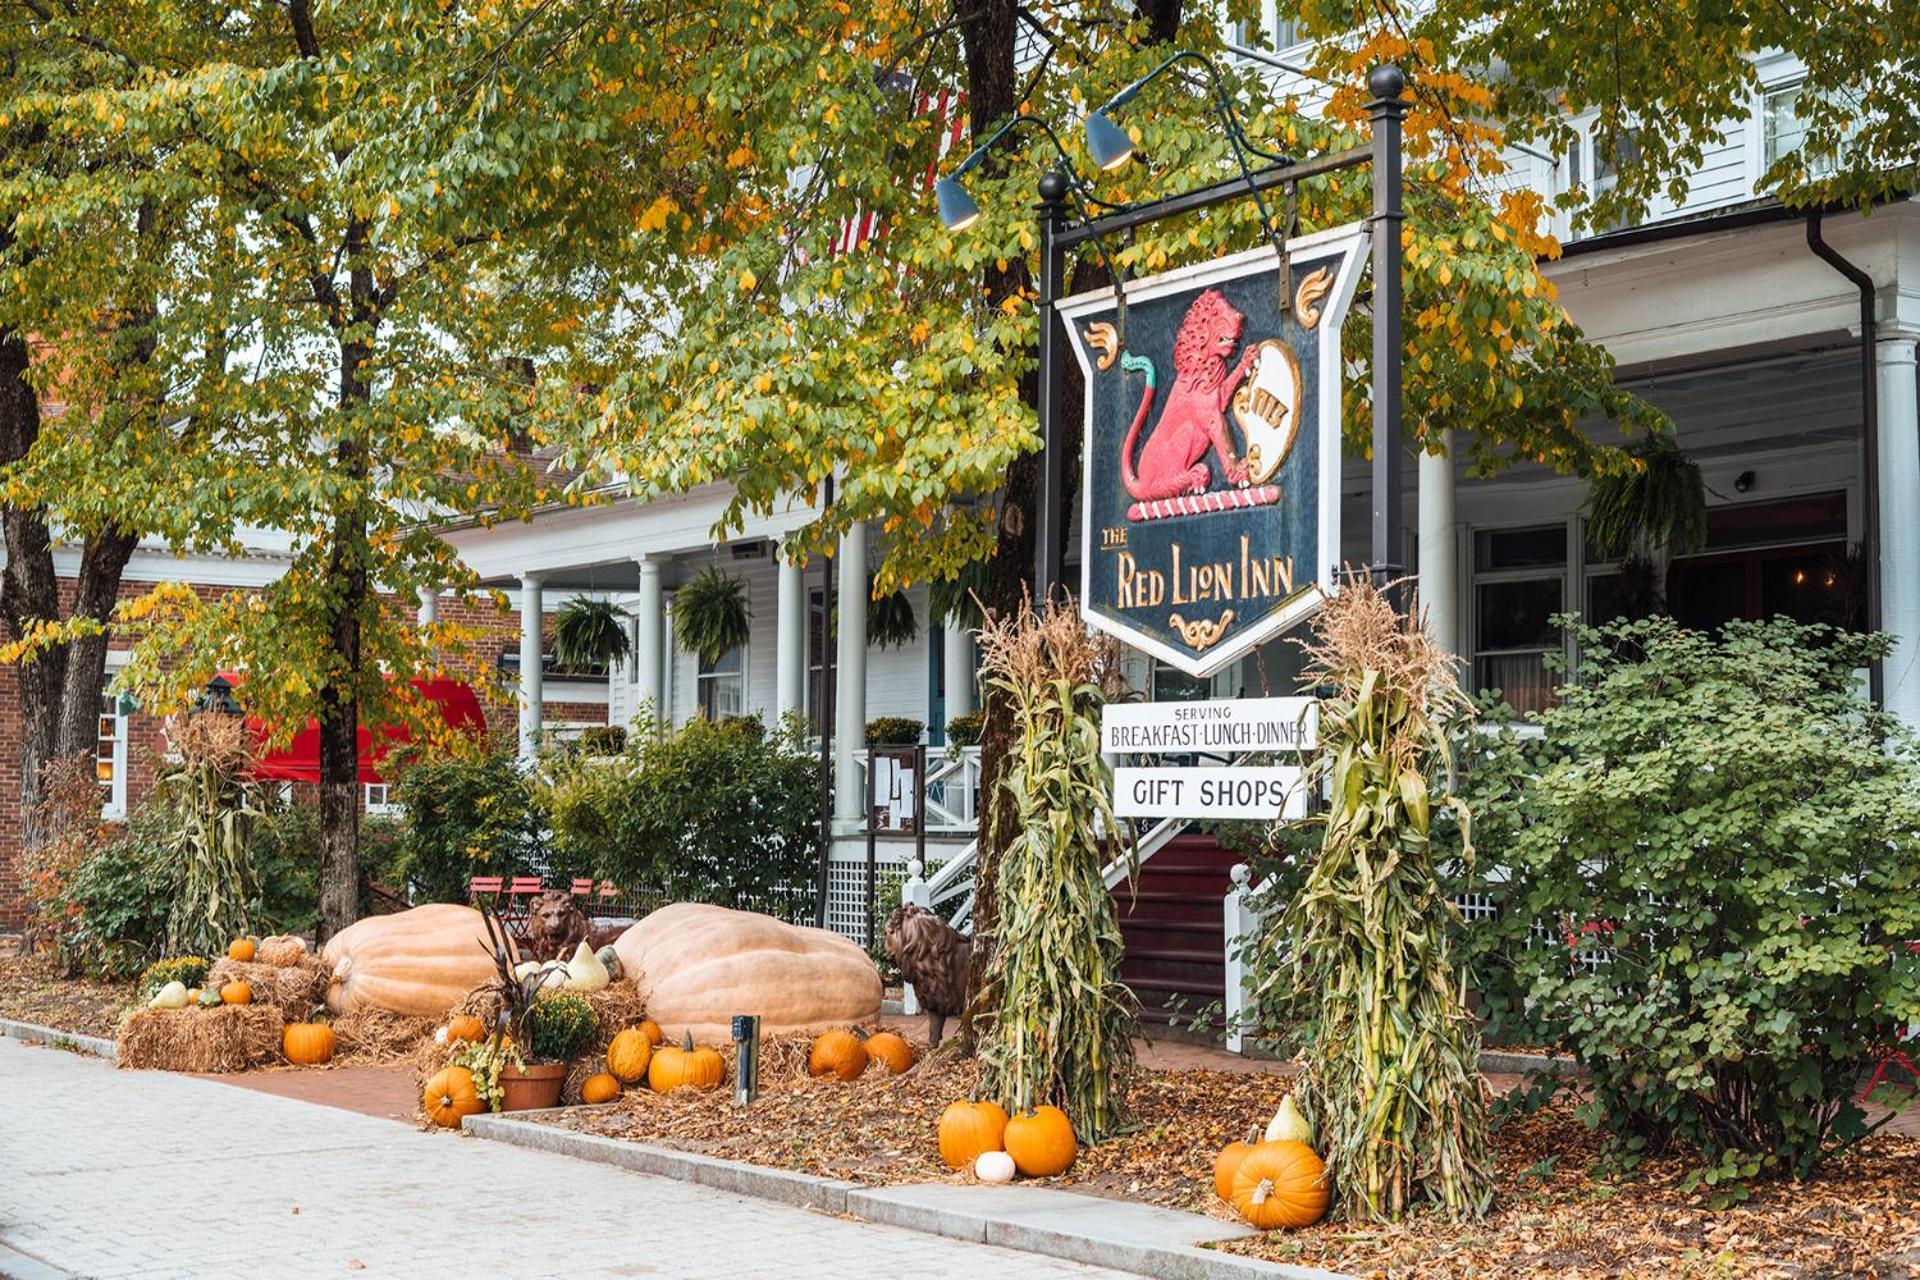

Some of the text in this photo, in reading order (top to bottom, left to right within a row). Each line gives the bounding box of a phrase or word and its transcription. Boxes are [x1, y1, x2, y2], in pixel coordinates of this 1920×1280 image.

[1102, 527, 1127, 545] THE
[1117, 533, 1293, 609] RED LION INN
[1174, 706, 1232, 721] SERVING
[1133, 779, 1284, 806] GIFT SHOPS
